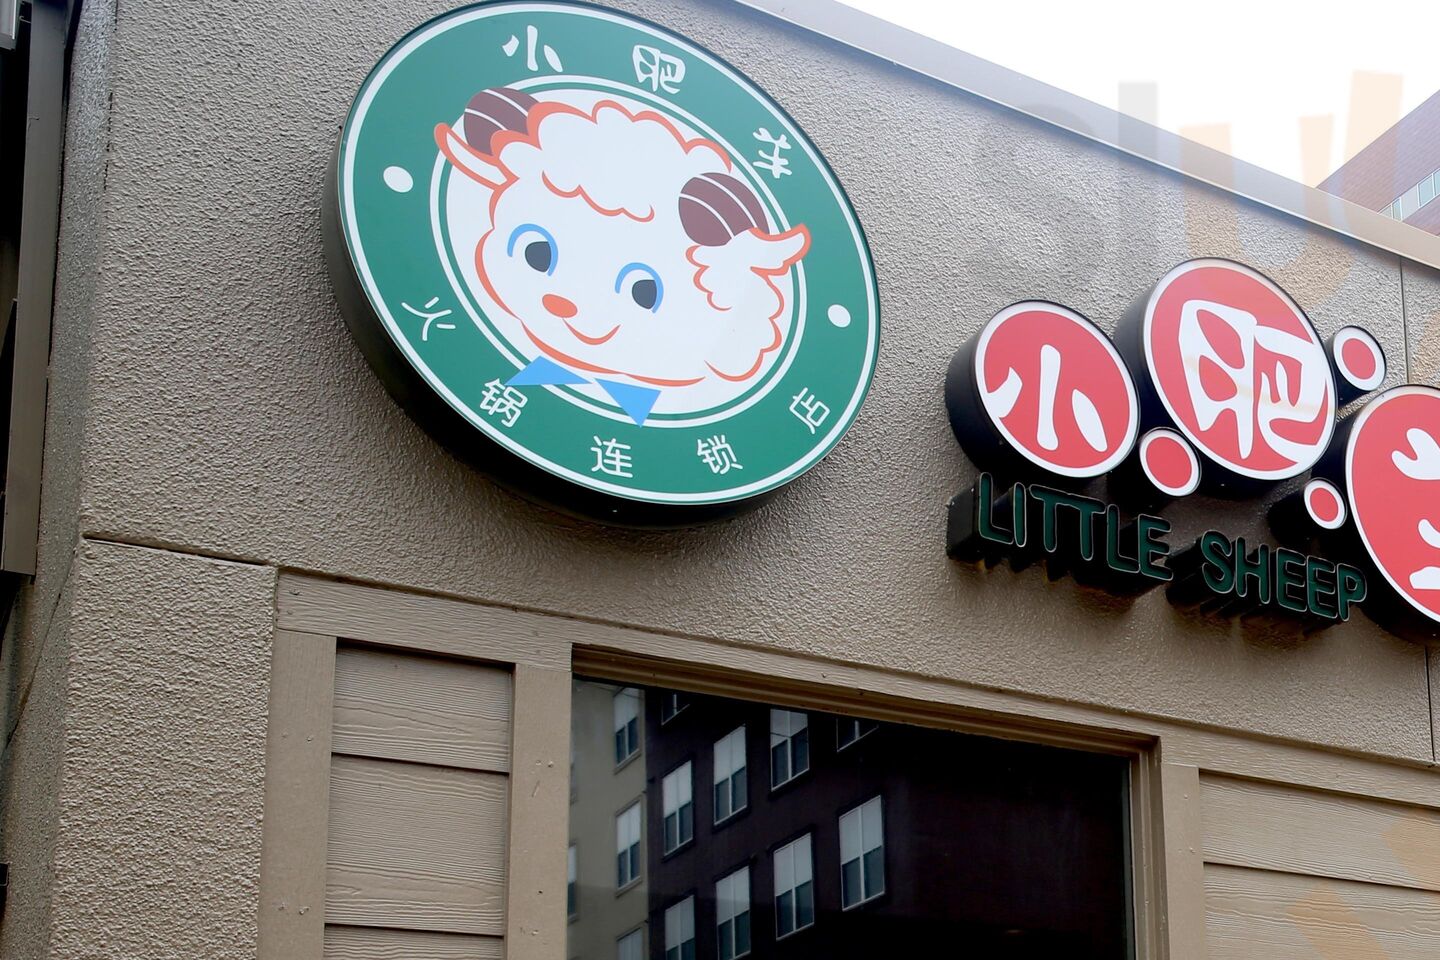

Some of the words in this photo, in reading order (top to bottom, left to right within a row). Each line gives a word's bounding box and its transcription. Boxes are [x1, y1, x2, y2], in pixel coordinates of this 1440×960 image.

[401, 296, 830, 479] 火锅连锁店
[979, 472, 1174, 581] LITTLE
[1201, 529, 1368, 622] SHEEP
